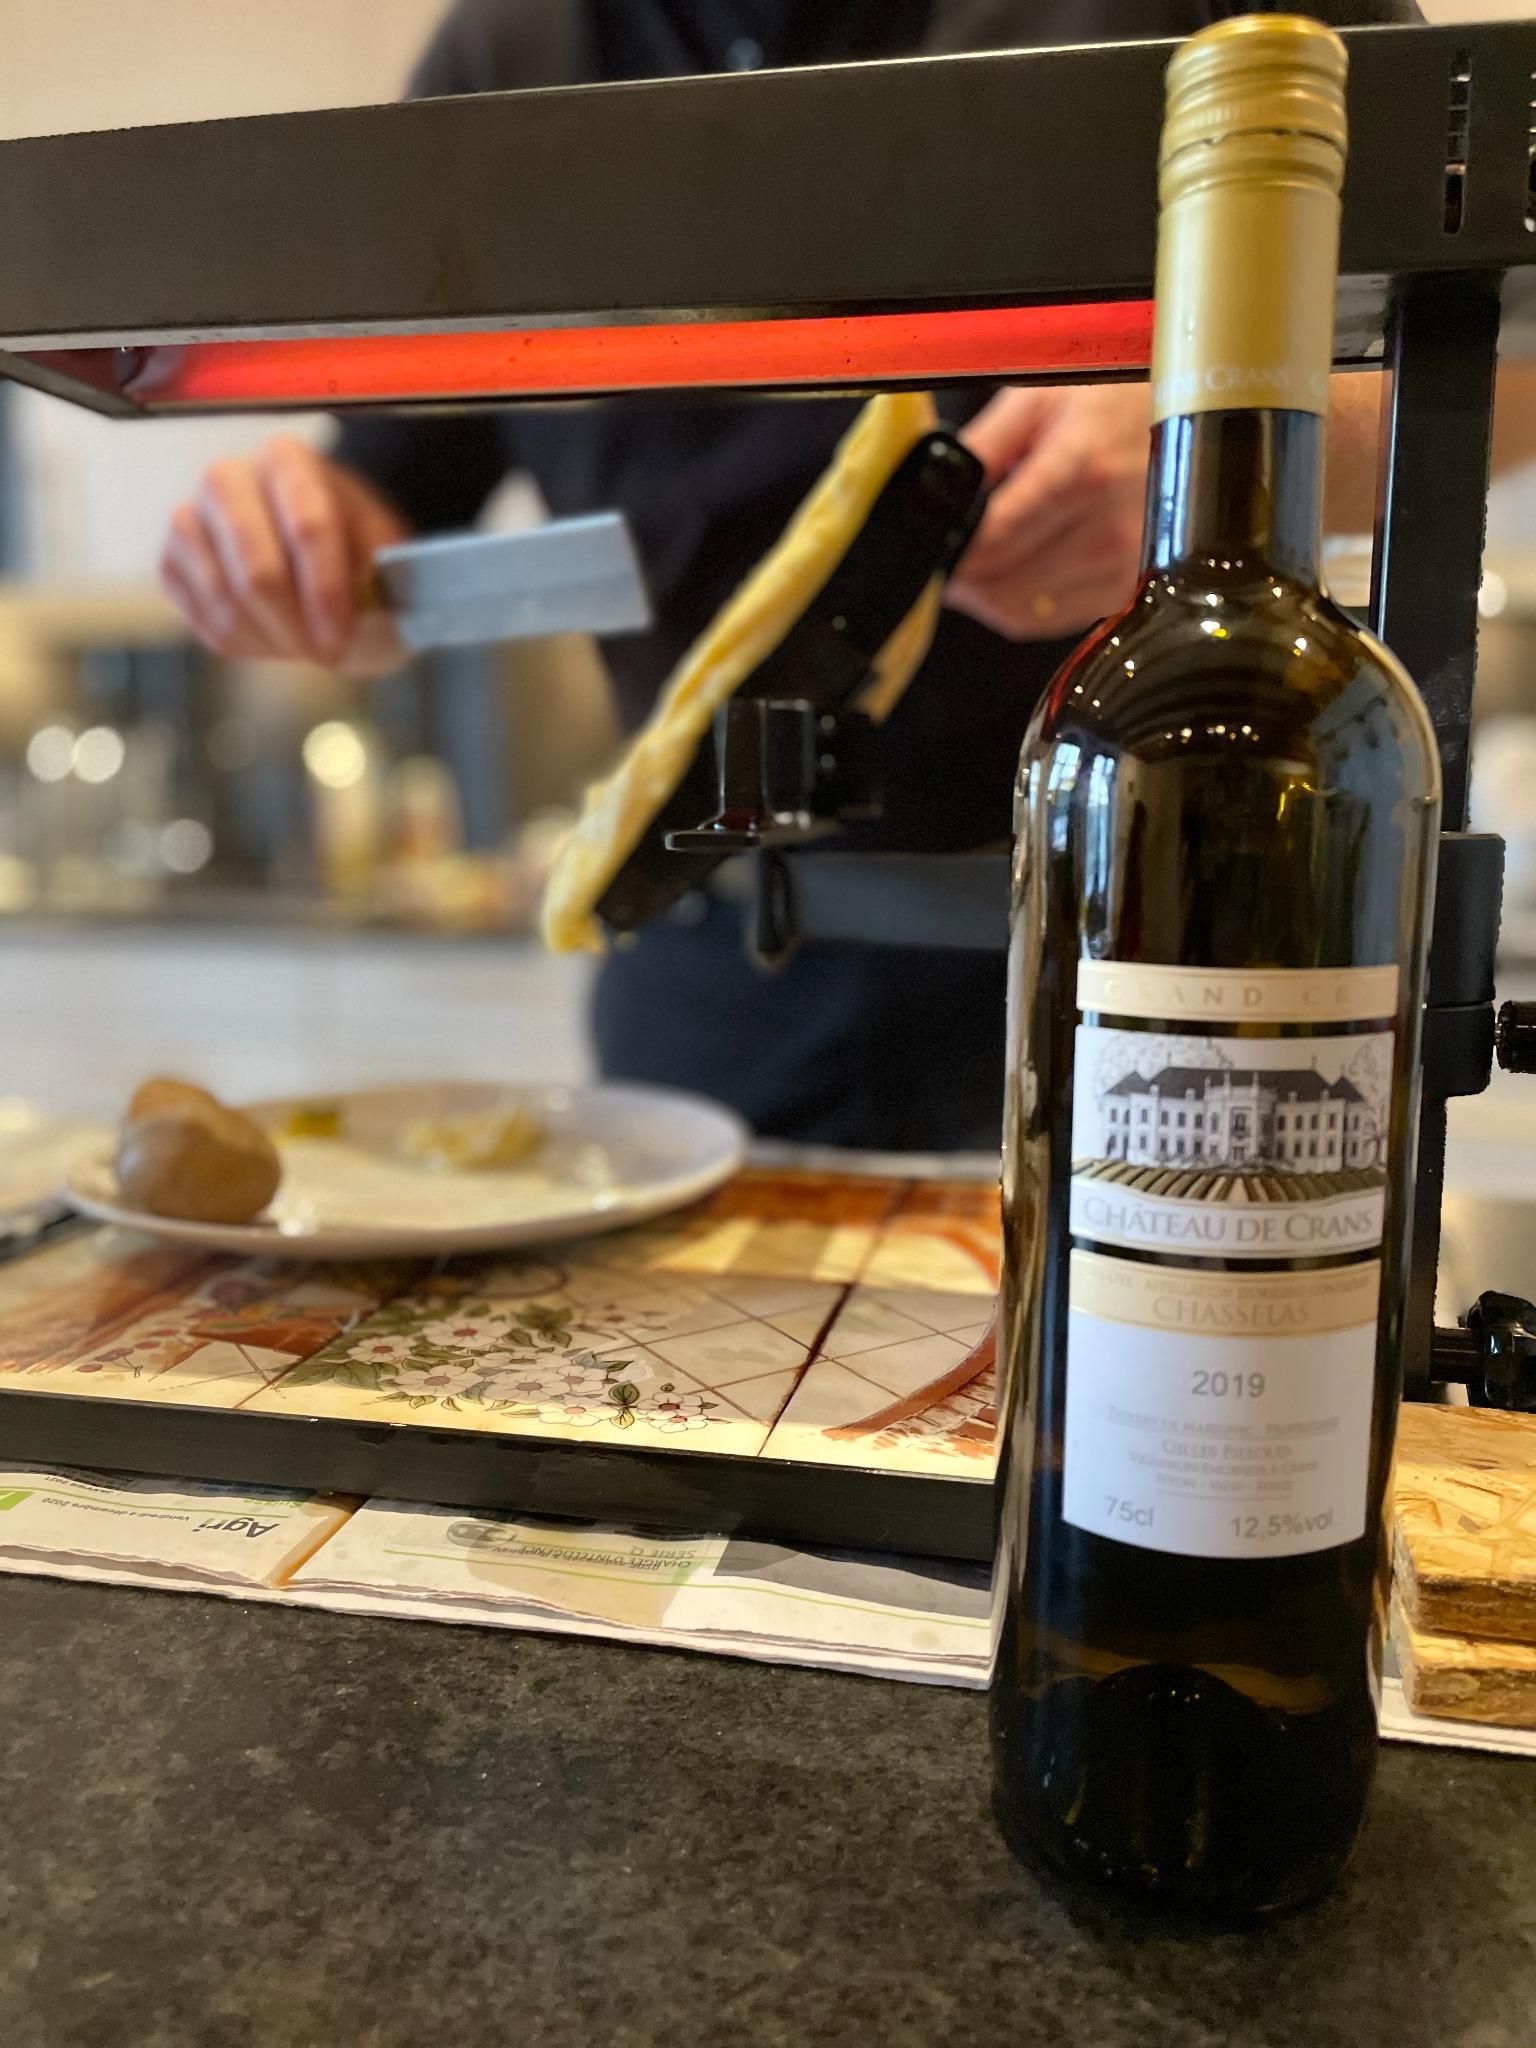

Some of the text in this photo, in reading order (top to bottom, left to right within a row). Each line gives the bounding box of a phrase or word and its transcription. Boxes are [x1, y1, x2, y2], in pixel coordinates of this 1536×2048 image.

[1084, 1196, 1375, 1243] CHÂTEAU DE CRANS
[1191, 1370, 1266, 1399] 2019
[42, 1497, 70, 1507] 2020
[72, 1502, 128, 1516] décembre
[1104, 1496, 1155, 1528] 75cl
[192, 1517, 280, 1538] Agri
